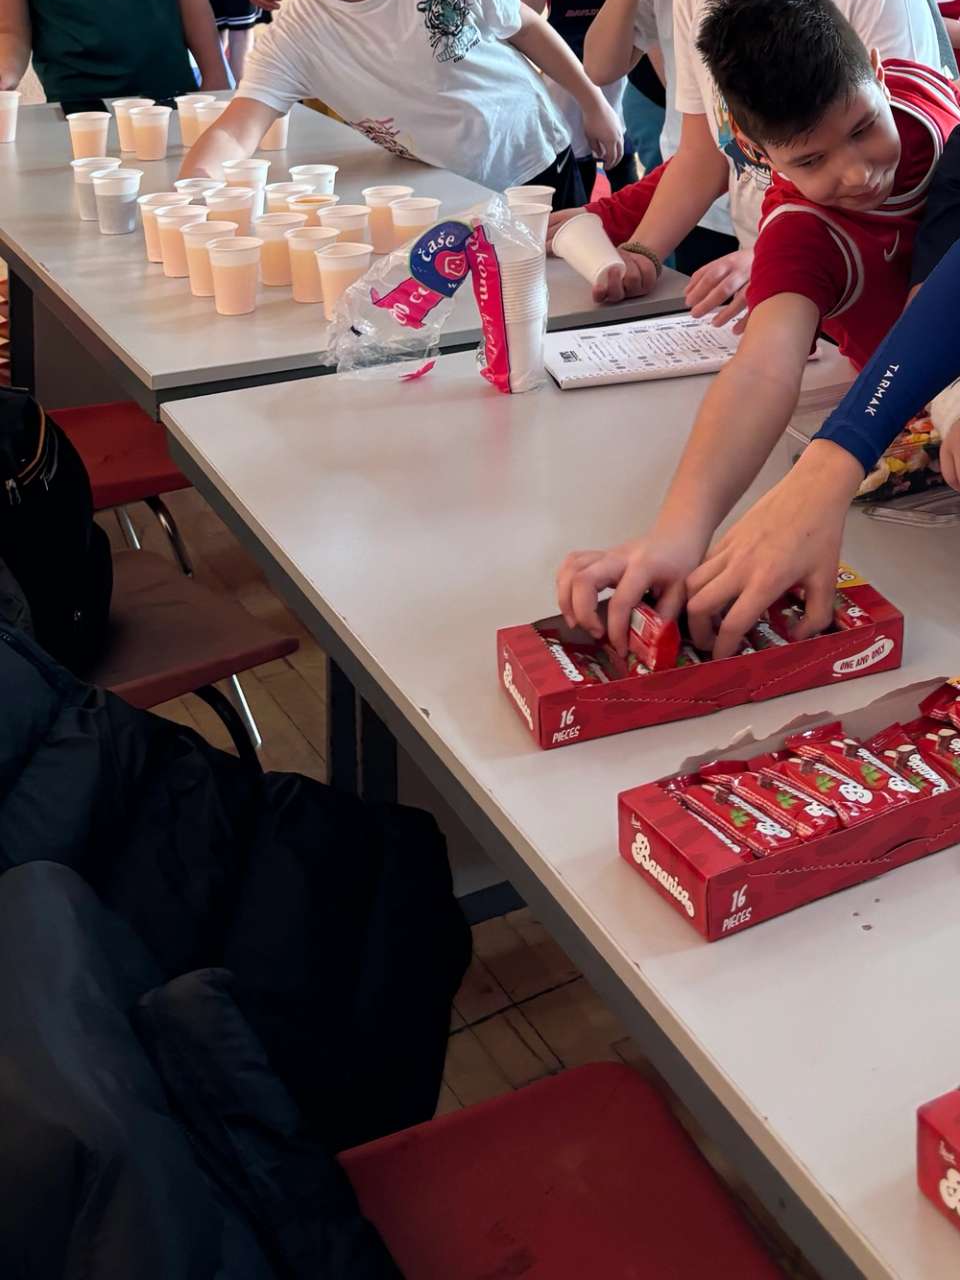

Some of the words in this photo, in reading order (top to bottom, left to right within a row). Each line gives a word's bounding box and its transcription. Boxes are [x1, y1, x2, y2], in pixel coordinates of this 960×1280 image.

[864, 364, 900, 417] TARMAK
[839, 659, 855, 671] ONE
[855, 654, 870, 668] AND
[871, 643, 886, 661] ONLY
[559, 706, 576, 729] 16
[552, 726, 581, 744] PIECES
[631, 832, 695, 918] Bananica
[730, 884, 748, 913] 16
[722, 907, 752, 932] PIECES
